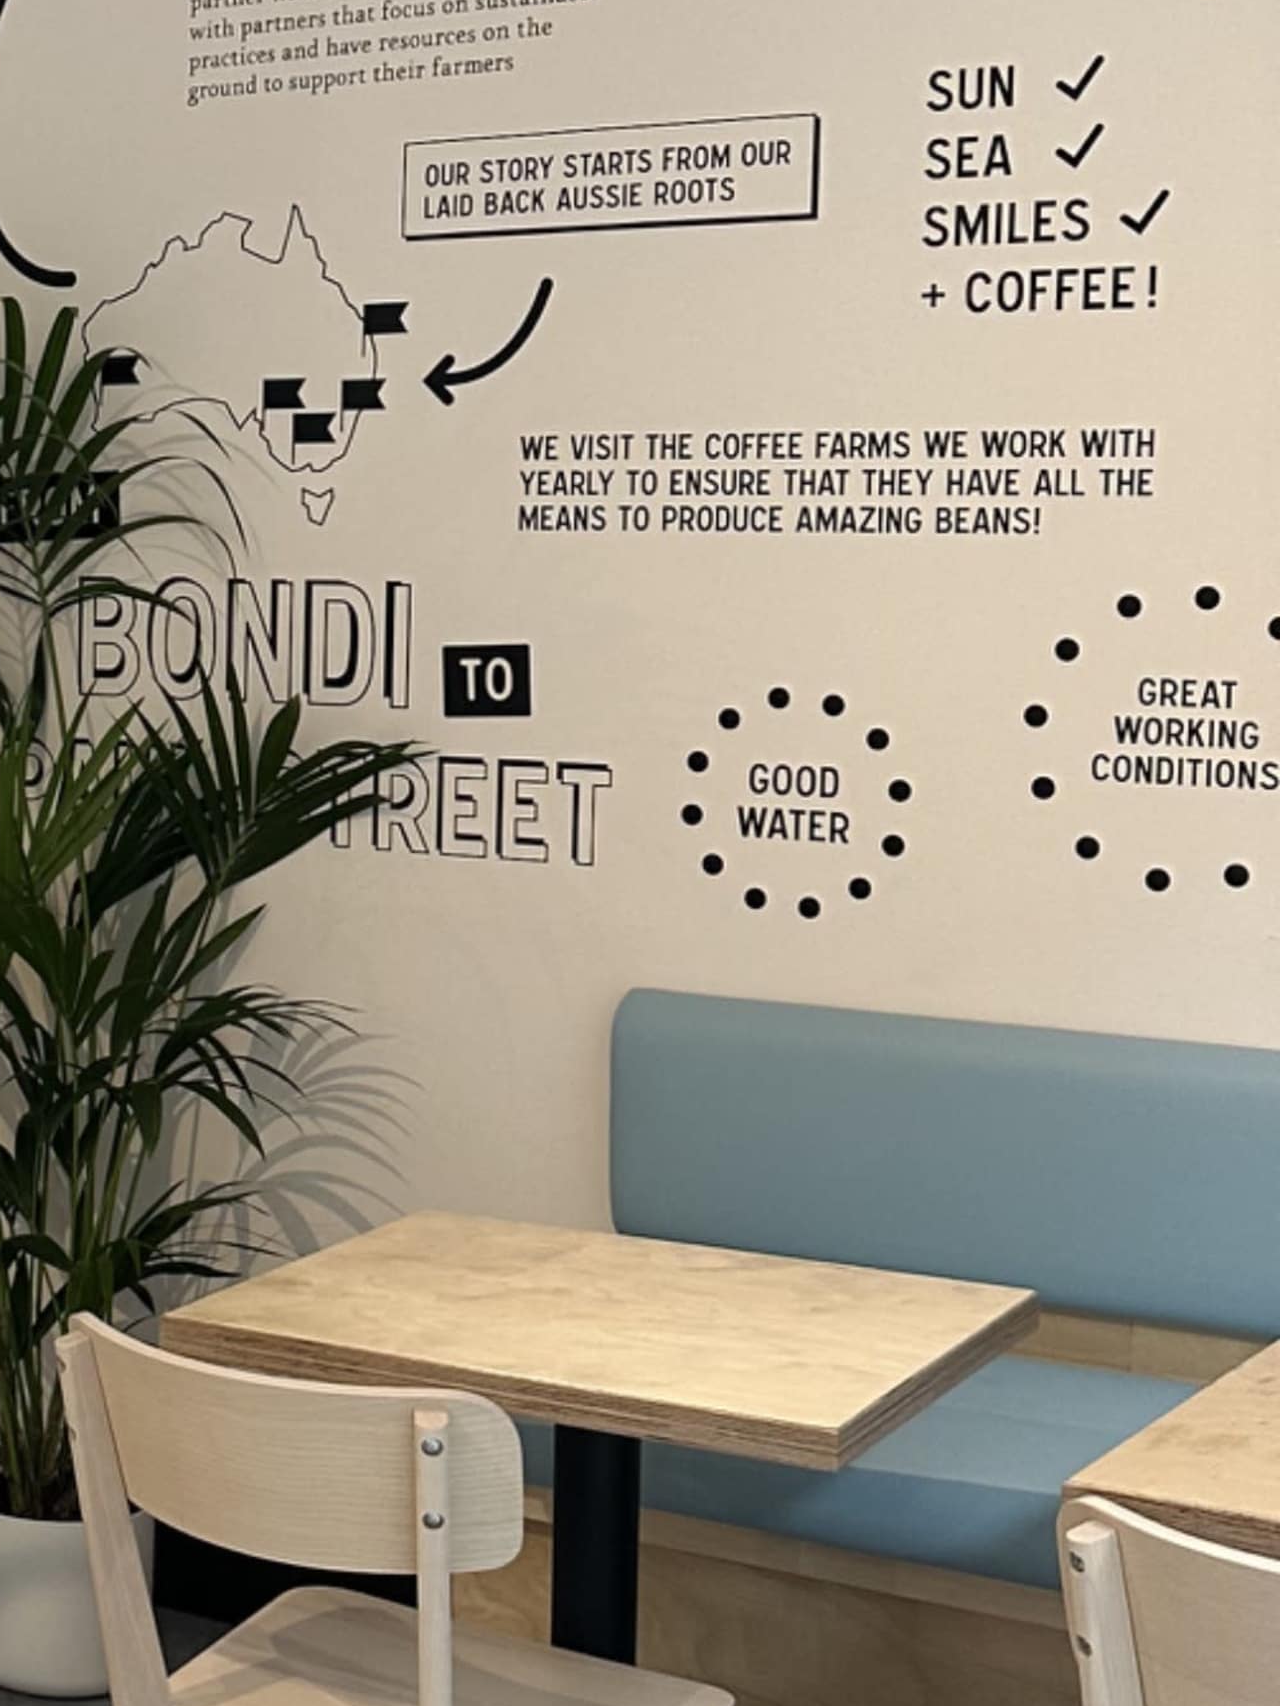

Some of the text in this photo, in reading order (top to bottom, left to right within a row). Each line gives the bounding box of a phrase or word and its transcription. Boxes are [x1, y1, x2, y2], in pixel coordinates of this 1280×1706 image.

[189, 17, 234, 40] with
[241, 13, 326, 43] partners
[332, 4, 374, 26] that
[382, 0, 435, 21] focus
[442, 0, 468, 15] on
[189, 16, 552, 77] practices and have resources on the
[187, 55, 514, 107] ground to support their farmers
[927, 65, 1014, 111] SUN
[425, 140, 791, 187] OUR STORY STARTS FROM OUR
[925, 135, 1011, 179] SEA
[424, 177, 734, 219] LAID BACK AUSSIE ROOTS
[923, 199, 1089, 247] SMILES
[966, 266, 1157, 313] COFFEE!
[520, 429, 1154, 460] WE VISIT THE COFFEE FARMS WE WORK WITH
[520, 469, 1153, 496] YEARLY TO ENSURE THAT THEY HAVE ALL THE
[519, 505, 1040, 534] MEANS TO PRODUCE AMAZING BEANS!
[79, 576, 412, 709] BONDI
[459, 657, 513, 702] TO
[1138, 678, 1237, 709] GREAT
[1115, 716, 1259, 749] WORKING
[749, 764, 839, 798] GOOD
[1092, 754, 1279, 790] CONDITIONS
[285, 748, 613, 866] REET
[738, 806, 849, 844] WATER
